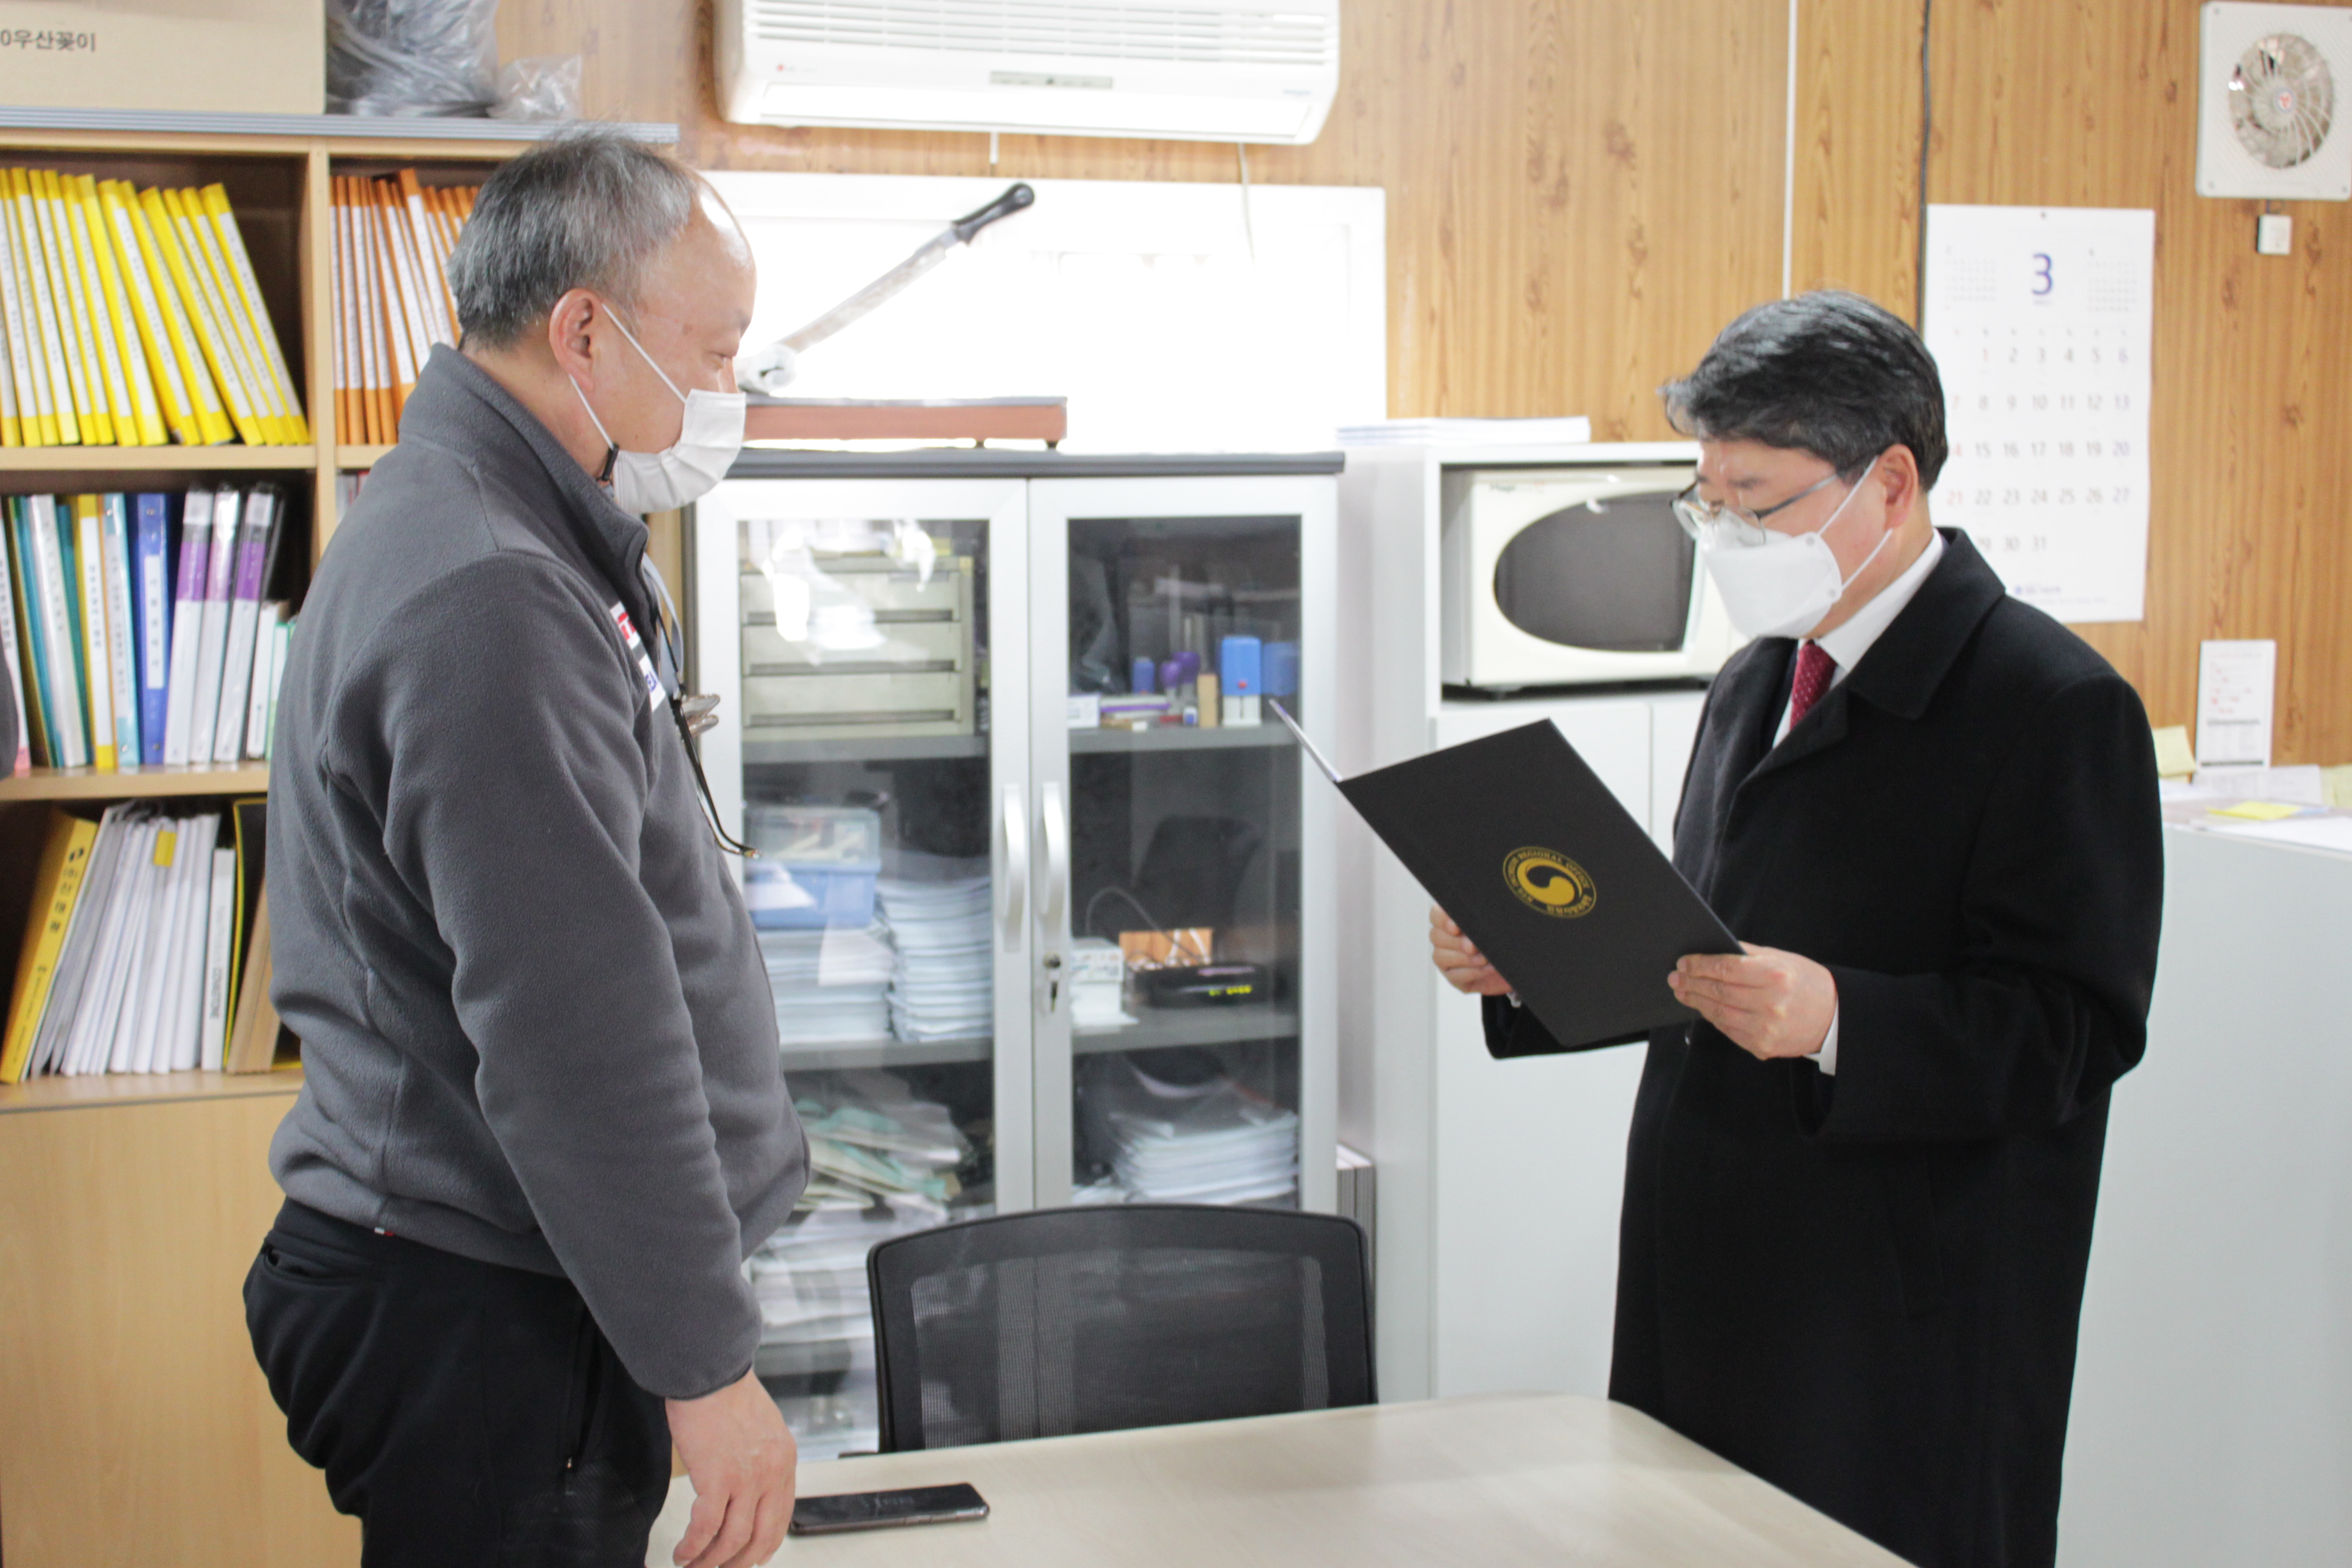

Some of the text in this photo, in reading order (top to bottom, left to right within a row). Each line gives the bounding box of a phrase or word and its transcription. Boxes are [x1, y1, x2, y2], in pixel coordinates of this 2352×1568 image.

[2031, 252, 2055, 296] 3
[2009, 347, 2018, 364] 2
[2038, 347, 2046, 364] 3
[2064, 347, 2074, 362] 4
[2092, 347, 2101, 364] 5
[2117, 347, 2128, 364] 6
[1979, 394, 1989, 411] 8
[2007, 394, 2017, 410] 9
[2032, 394, 2048, 410] 10
[2060, 394, 2074, 410] 11
[2087, 394, 2103, 410] 12
[2115, 394, 2130, 410] 13
[1975, 442, 1992, 458] 15
[2003, 441, 2020, 458] 16
[2031, 441, 2047, 457] 17
[2058, 441, 2075, 457] 18
[2086, 441, 2102, 456] 19
[2113, 441, 2130, 457] 20
[1947, 487, 2130, 506] 21 22 23 24 25 26 27
[2005, 536, 2020, 552] 30
[2033, 535, 2047, 551] 31
